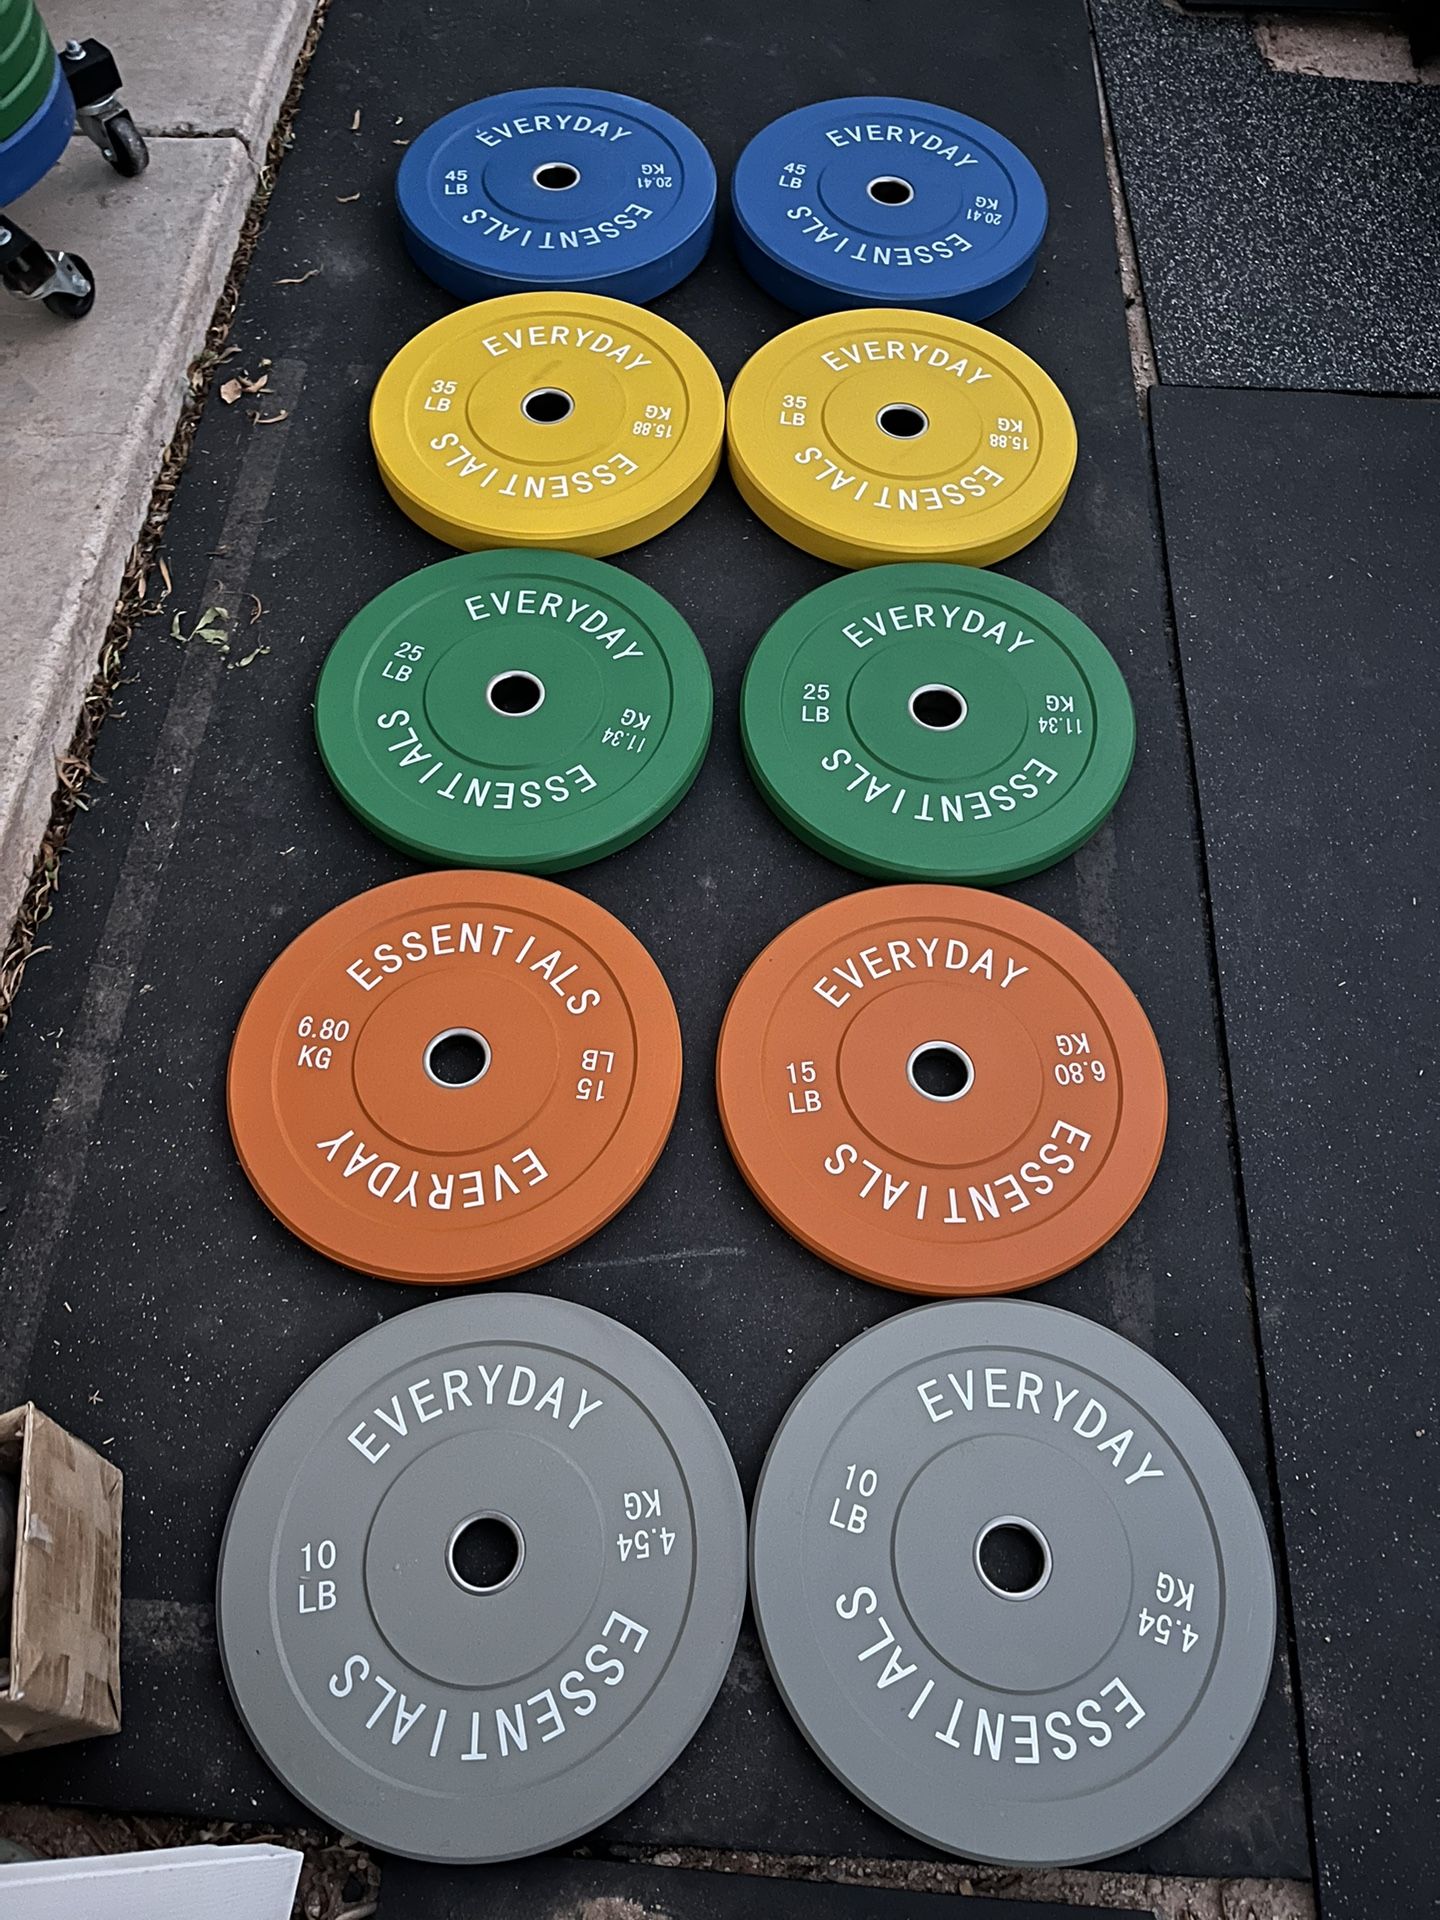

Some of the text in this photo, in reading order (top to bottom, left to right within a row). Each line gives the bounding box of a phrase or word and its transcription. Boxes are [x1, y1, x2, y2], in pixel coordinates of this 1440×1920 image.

[475, 114, 633, 147] EVERYDAY
[825, 124, 979, 167] EVERYDAY
[444, 169, 469, 182] 45
[641, 163, 665, 175] KG
[778, 174, 803, 189] LB
[783, 162, 808, 176] 45
[444, 183, 469, 195] LB
[637, 176, 673, 189] 20.41
[975, 195, 999, 211] KG
[462, 203, 654, 249] ESSENTIALS
[966, 208, 1003, 226] 20.41
[786, 206, 973, 266] ESSENTIALS
[481, 325, 652, 371] EVERYDAY
[820, 340, 993, 384] EVERYDAY
[430, 379, 458, 395] 35
[423, 396, 452, 412] LB
[644, 404, 672, 421] KG
[782, 394, 807, 410] 35
[632, 420, 672, 439] 15.88
[779, 410, 806, 427] LB
[997, 417, 1023, 433] KG
[989, 433, 1029, 451] 15.88
[430, 432, 640, 499] ESSENTIALS
[794, 446, 1006, 511] ESSENTIALS
[464, 590, 644, 660] EVERYDAY
[841, 603, 1035, 653] EVERYDAY
[393, 641, 425, 662] 25
[381, 660, 413, 682] LB
[802, 683, 830, 701] 25
[1045, 694, 1074, 713] KG
[620, 708, 652, 731] KG
[801, 705, 830, 723] LB
[1038, 716, 1083, 735] 11.34
[601, 727, 646, 753] 11.34
[377, 709, 598, 810] ESSENTIALS
[821, 748, 1059, 823] ESSENTIALS
[345, 922, 601, 1015] ESSENTIALS
[812, 937, 1029, 1008] EVERYDAY
[297, 1015, 350, 1042] 6.80
[297, 1044, 332, 1070] KG
[1055, 1032, 1091, 1056] KG
[581, 1049, 615, 1073] LB
[786, 1060, 816, 1084] 15
[1054, 1060, 1106, 1086] 6.80
[575, 1077, 605, 1102] 15
[788, 1089, 822, 1114] LB
[316, 1129, 549, 1210] EVERYDAY
[824, 1119, 1092, 1224] ESSENTIALS
[347, 1364, 603, 1464] EVERYDAY
[917, 1368, 1165, 1485] EVERYDAY
[845, 1464, 878, 1497] 10
[623, 1488, 661, 1520] KG
[829, 1497, 868, 1534] LB
[301, 1540, 336, 1572] 10
[616, 1527, 676, 1562] 4.54
[299, 1580, 337, 1614] LB
[1156, 1571, 1195, 1612] KG
[1138, 1607, 1199, 1653] 4.54
[329, 1610, 649, 1761] ESSENTIALS
[835, 1586, 1146, 1764] ESSENTIALS
